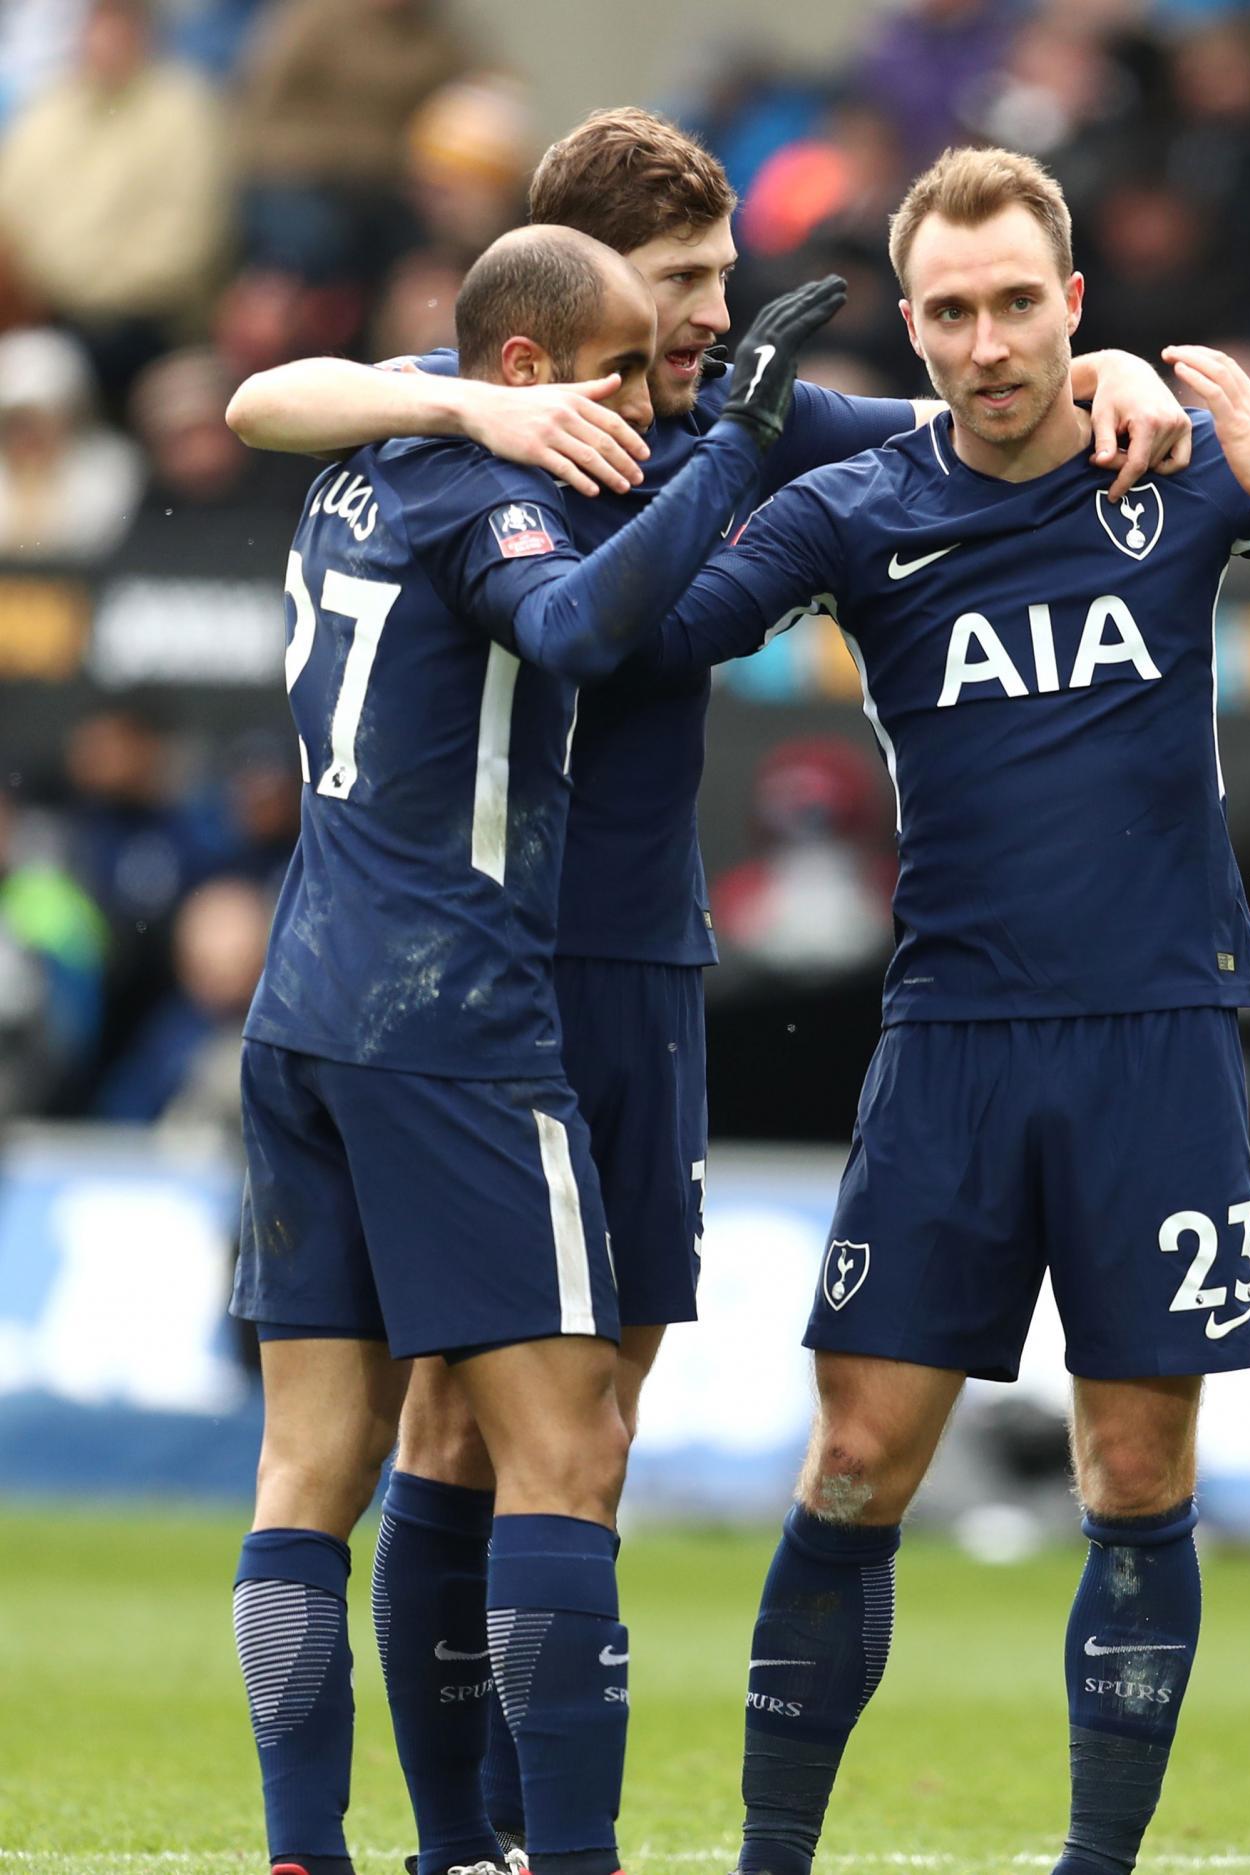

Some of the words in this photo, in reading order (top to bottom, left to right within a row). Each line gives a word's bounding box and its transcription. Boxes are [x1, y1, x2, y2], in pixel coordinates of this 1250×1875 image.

[936, 594, 1162, 708] AIA
[439, 1678, 495, 1703] SPUR
[1084, 1677, 1172, 1704] SPURS
[745, 1692, 803, 1717] PURS
